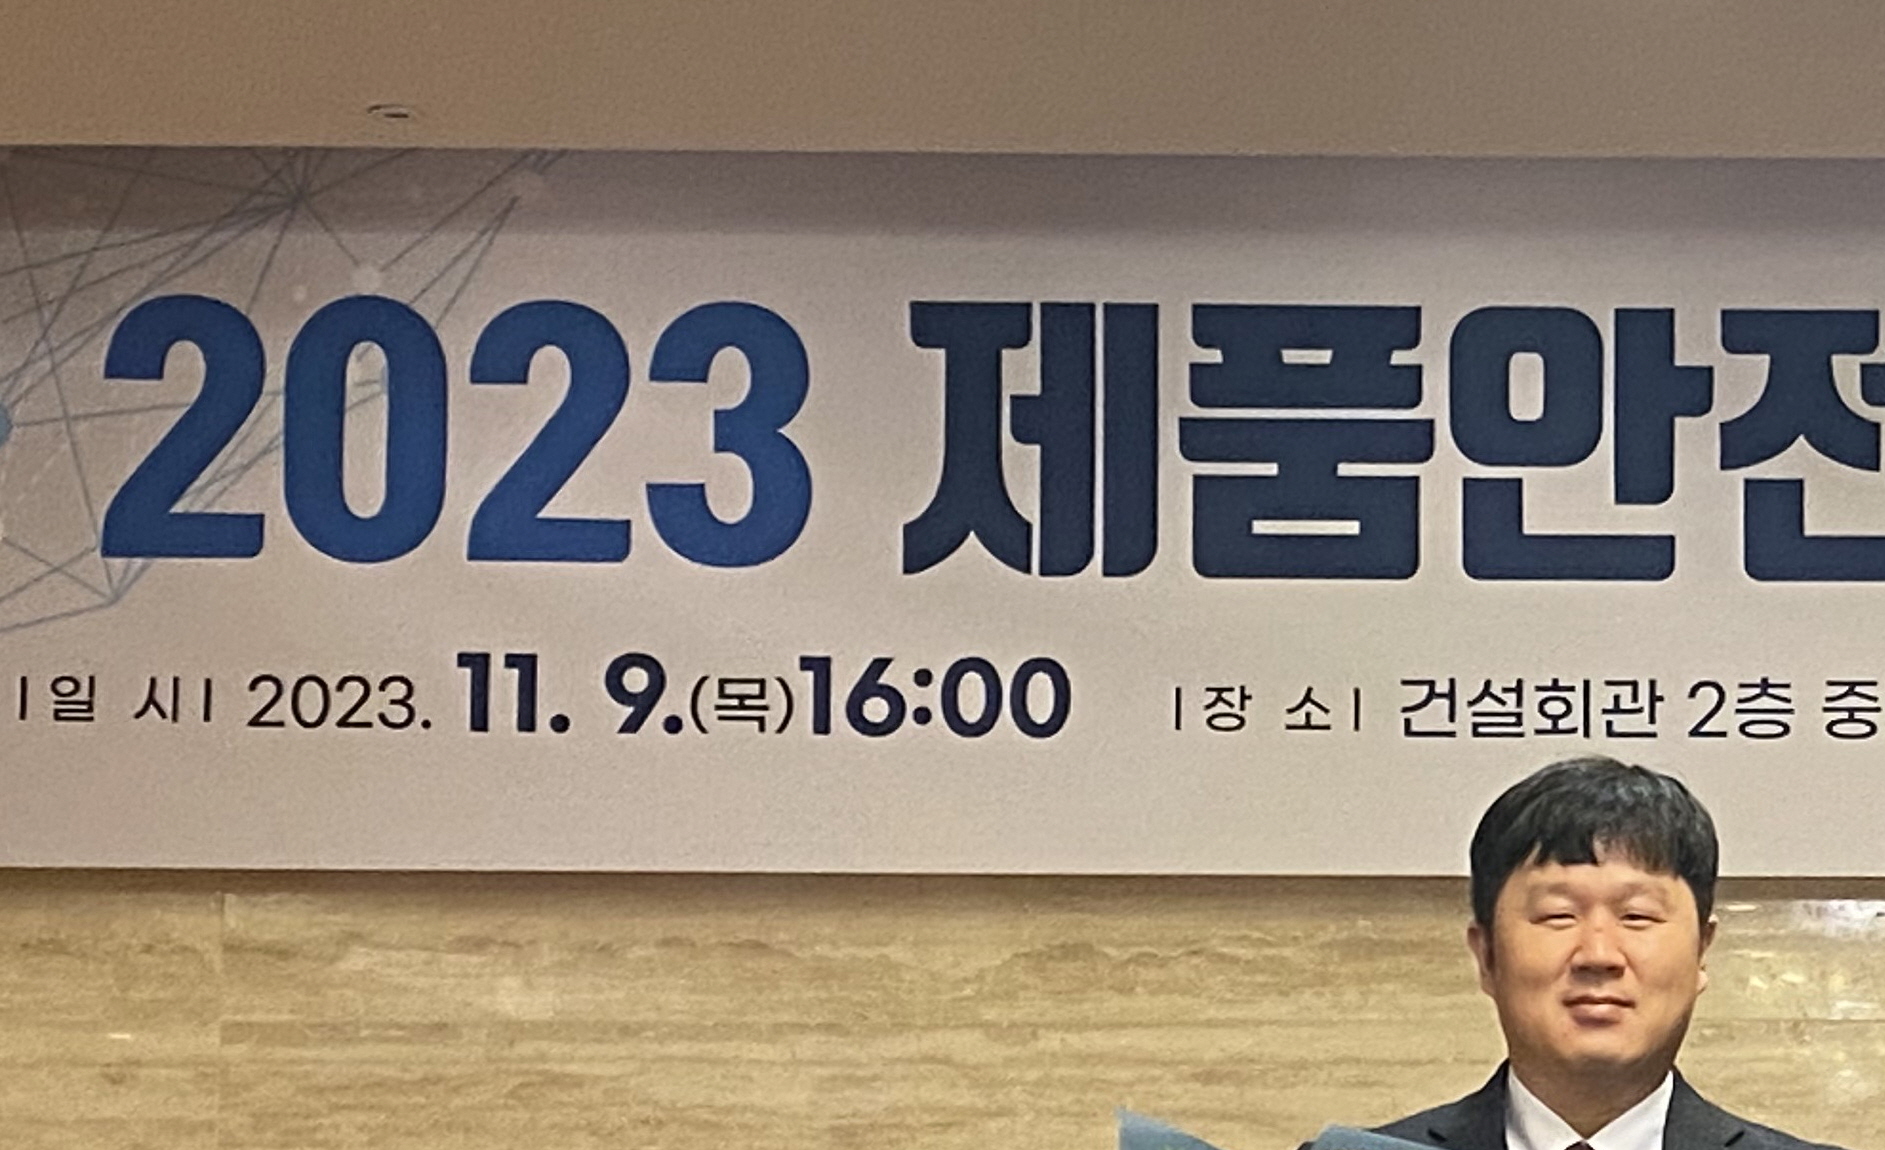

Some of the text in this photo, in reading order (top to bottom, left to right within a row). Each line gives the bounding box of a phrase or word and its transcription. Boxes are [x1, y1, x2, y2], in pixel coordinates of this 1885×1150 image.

[101, 294, 813, 569] 2023
[246, 672, 432, 730] 2023.
[456, 651, 571, 735] 11.
[1399, 677, 1665, 740] 건설회관
[1687, 676, 1796, 740] 2층
